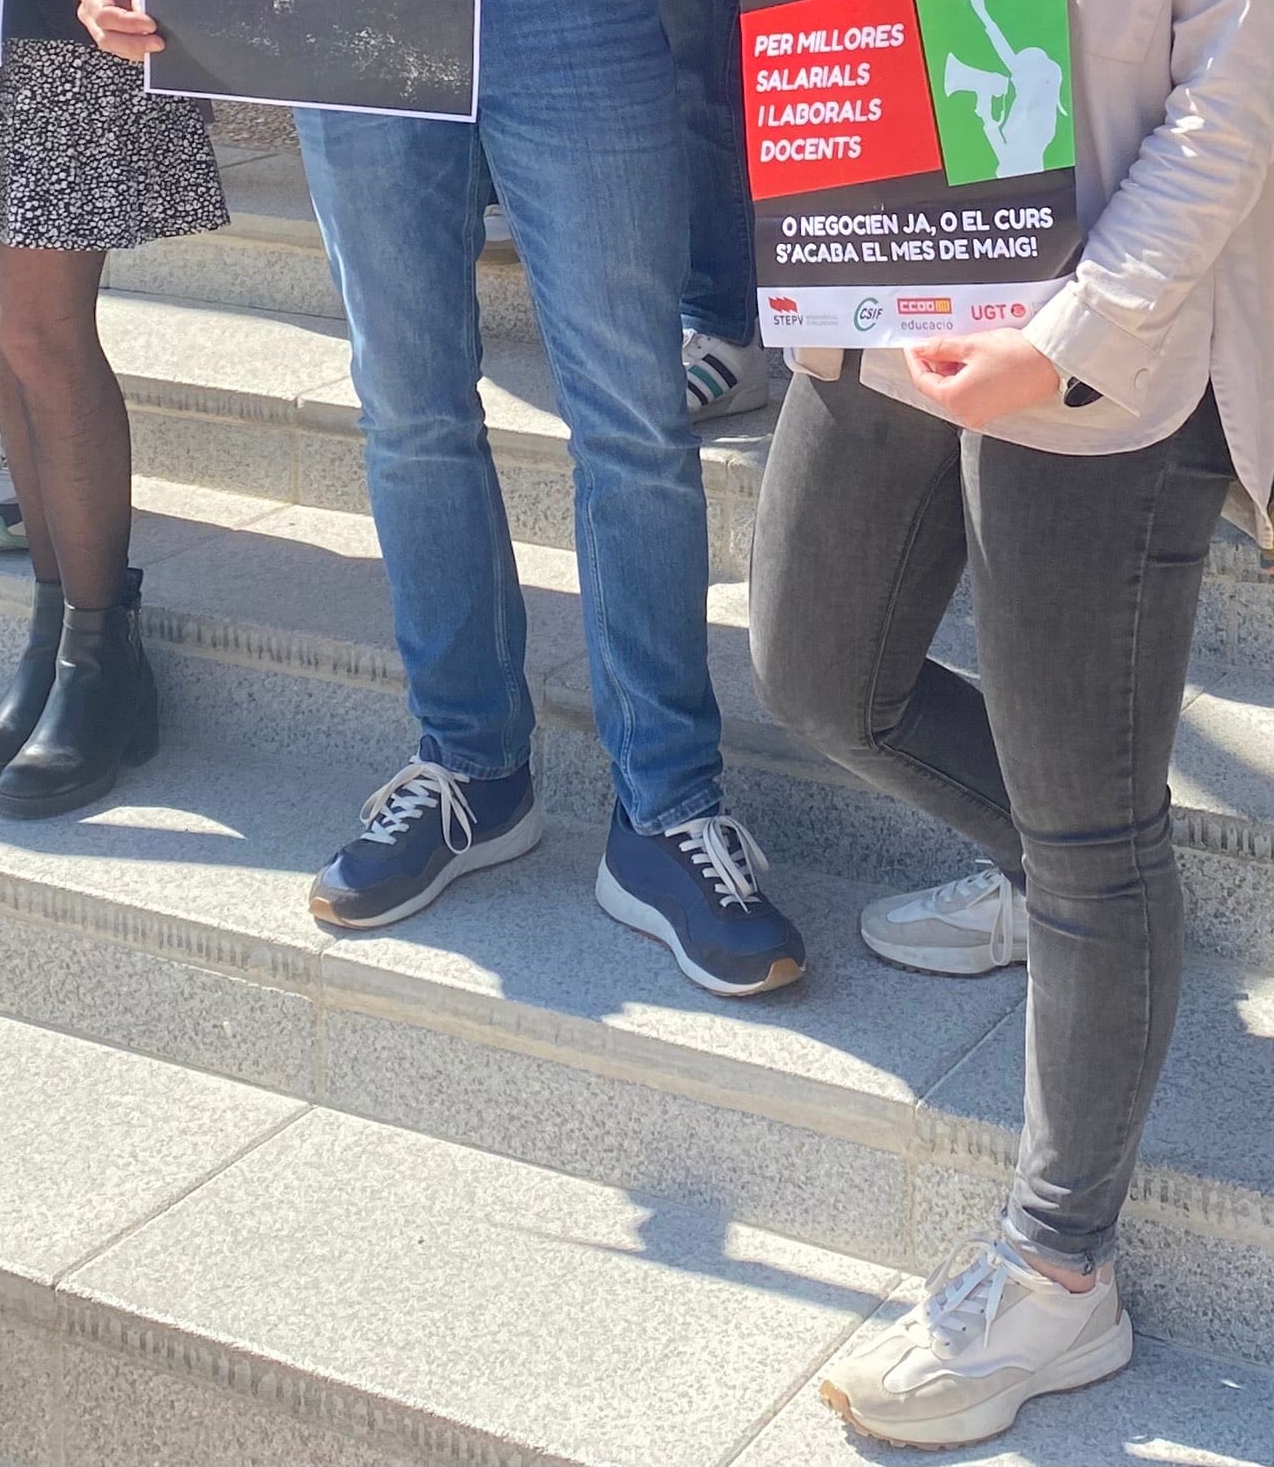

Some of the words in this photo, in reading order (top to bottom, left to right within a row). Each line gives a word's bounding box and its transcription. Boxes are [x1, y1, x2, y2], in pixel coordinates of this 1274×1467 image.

[754, 32, 794, 57] PER
[797, 24, 905, 54] MILLORES
[756, 63, 870, 93] SALARIALS
[758, 105, 765, 127] I
[769, 99, 882, 127] LABORALS
[760, 136, 861, 163] DOCENTS
[782, 217, 797, 237] O
[800, 214, 898, 236] NEGOCIEN
[903, 214, 936, 237] JA,
[940, 212, 957, 231] O
[962, 210, 989, 231] EL
[994, 207, 1054, 229] CURS
[776, 243, 859, 264] S'ACABA
[863, 242, 887, 262] EL
[892, 240, 934, 261] MES
[940, 240, 969, 260] DE
[974, 237, 1038, 258] MAIG!
[774, 315, 804, 326] STEPV
[859, 307, 883, 320] CSIF
[971, 305, 1006, 321] UGT
